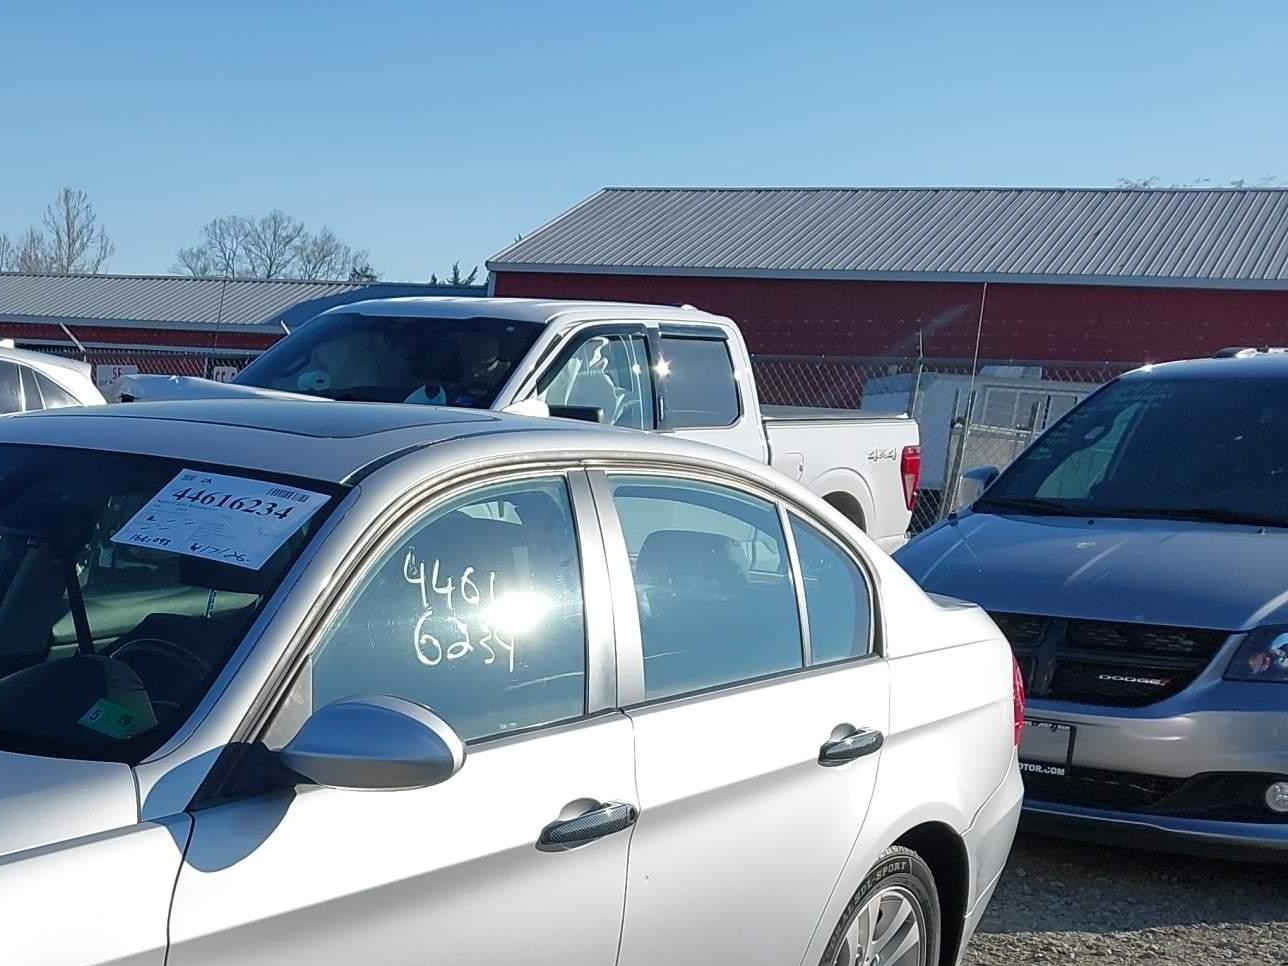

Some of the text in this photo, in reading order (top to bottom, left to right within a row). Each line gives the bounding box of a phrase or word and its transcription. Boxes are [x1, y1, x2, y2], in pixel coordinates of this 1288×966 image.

[172, 487, 296, 520] 44616234
[403, 546, 497, 609] 4461
[414, 609, 515, 673] 6234
[1098, 673, 1167, 686] DODGE
